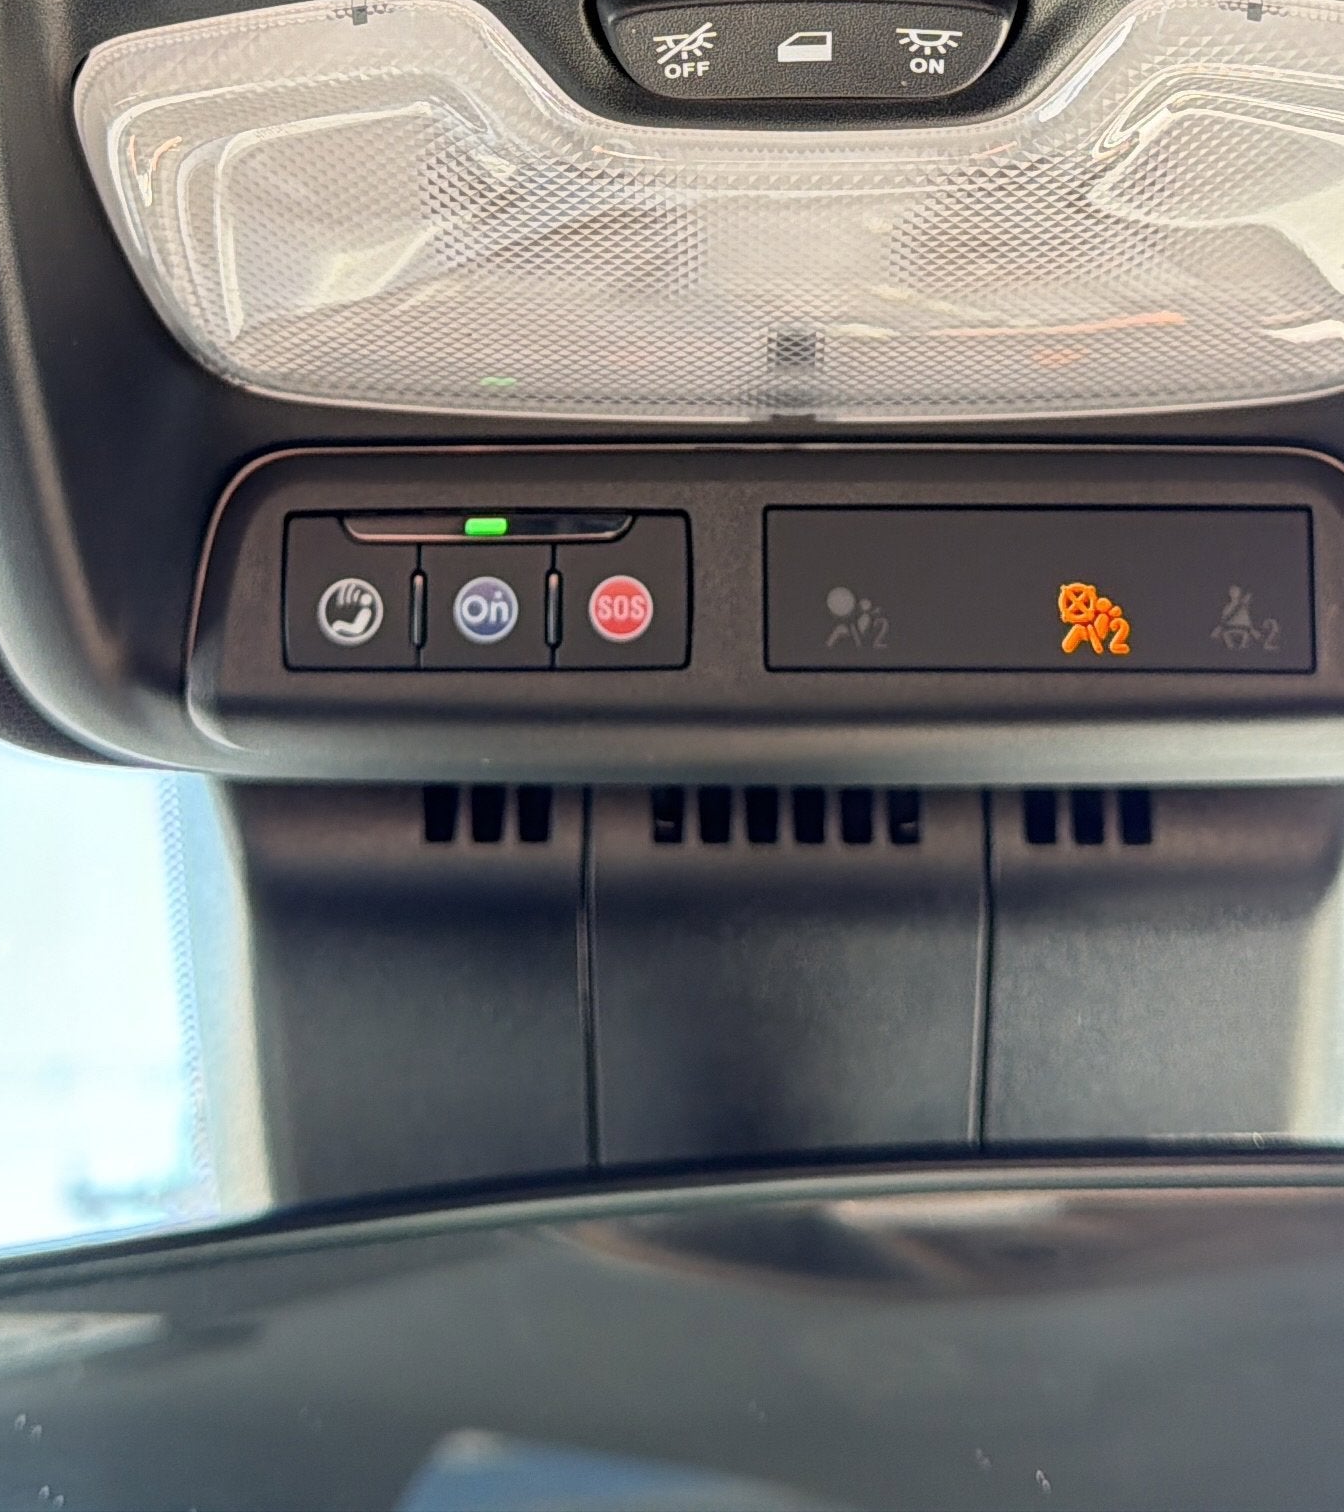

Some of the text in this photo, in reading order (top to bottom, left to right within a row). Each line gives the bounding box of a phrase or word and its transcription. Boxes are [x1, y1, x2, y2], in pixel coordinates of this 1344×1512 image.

[664, 61, 709, 79] OFF
[909, 58, 945, 75] ON
[596, 595, 646, 620] SOS
[873, 618, 888, 648] 2
[1109, 619, 1130, 653] 2
[1262, 618, 1280, 650] 2
